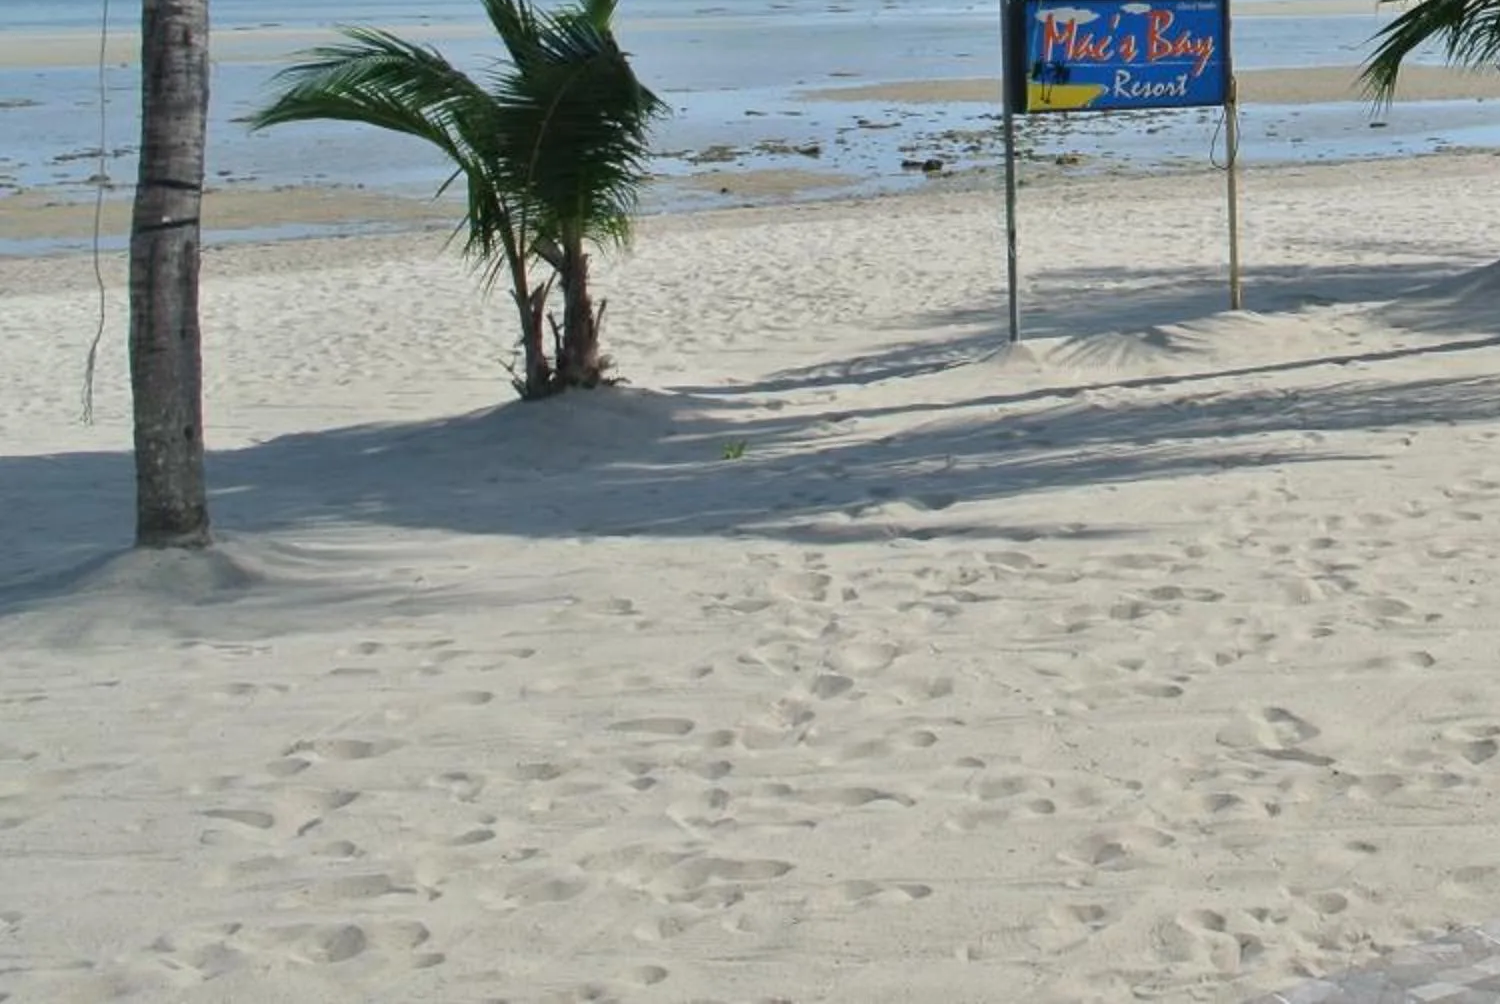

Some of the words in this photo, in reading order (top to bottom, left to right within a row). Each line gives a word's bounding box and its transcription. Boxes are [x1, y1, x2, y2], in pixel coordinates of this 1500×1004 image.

[1043, 13, 1138, 62] Mac's
[1147, 10, 1215, 76] Bay
[1113, 69, 1188, 98] Resort
